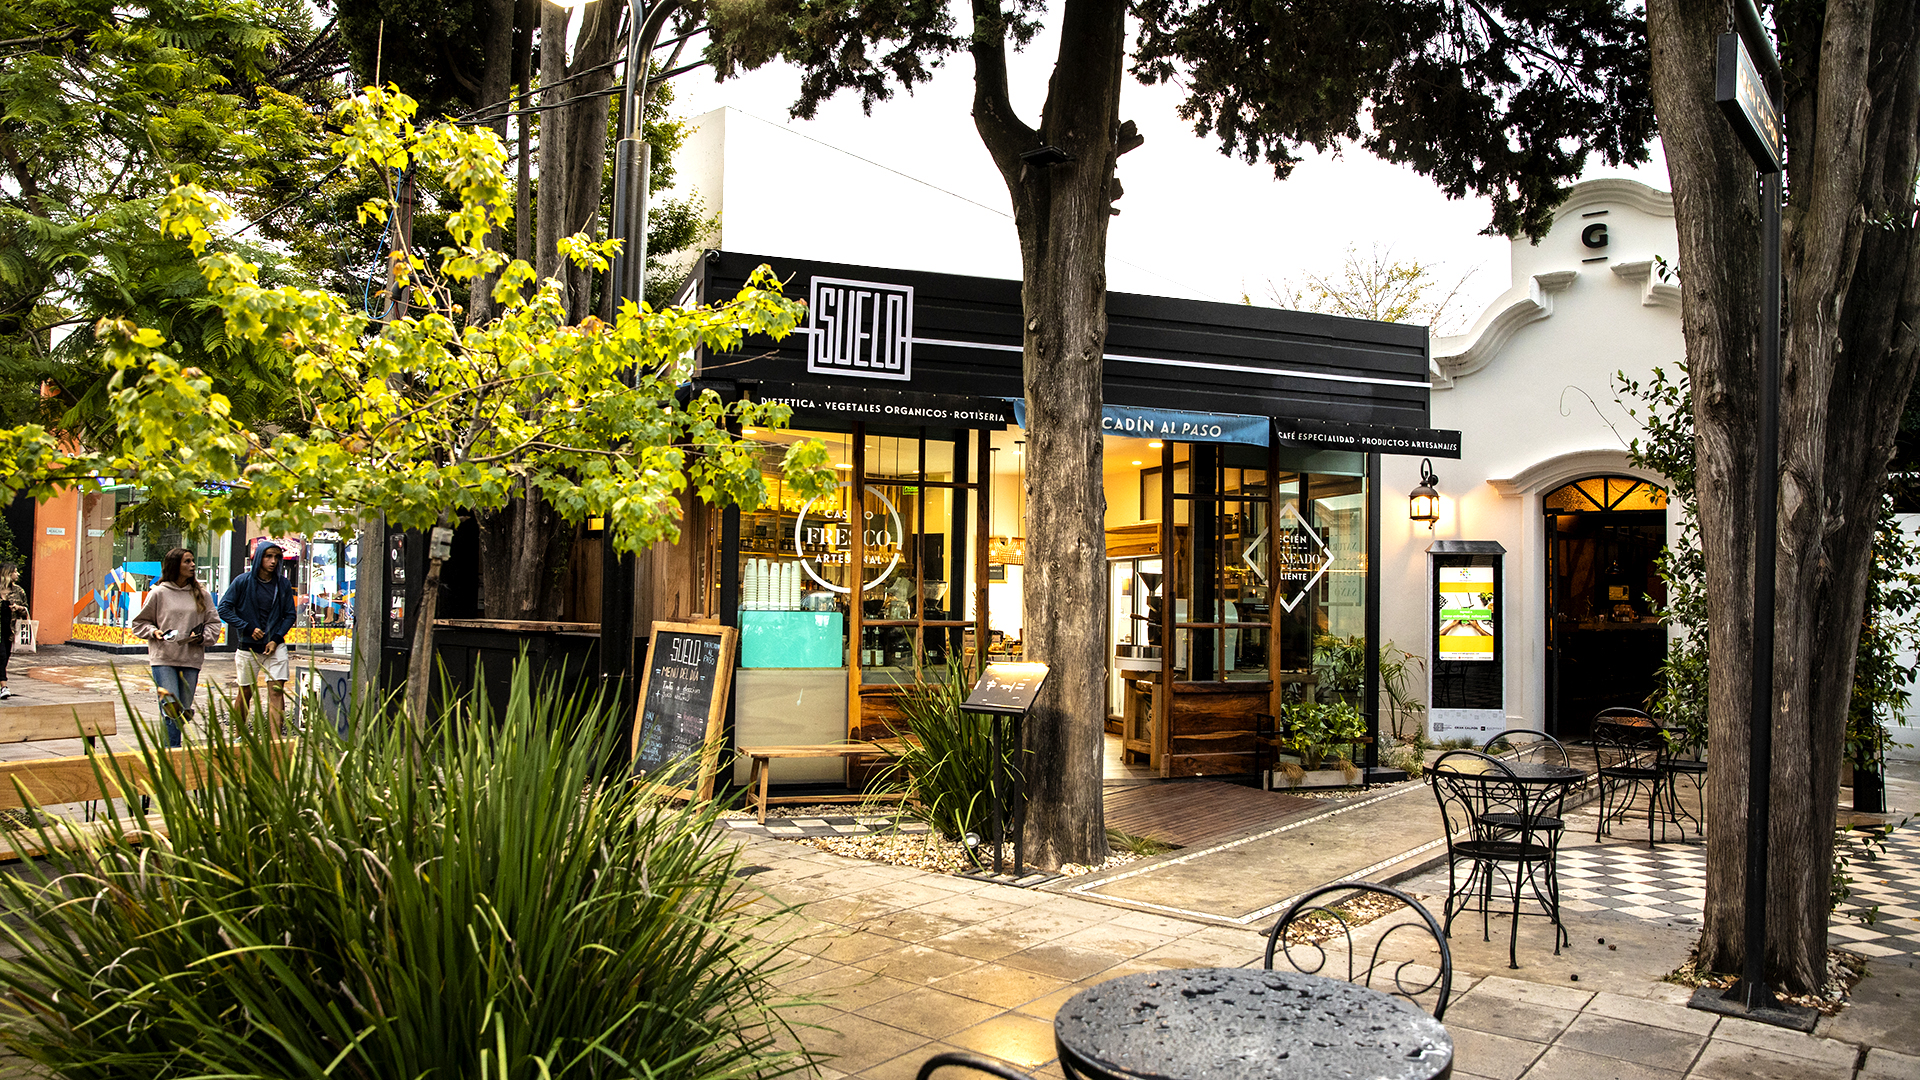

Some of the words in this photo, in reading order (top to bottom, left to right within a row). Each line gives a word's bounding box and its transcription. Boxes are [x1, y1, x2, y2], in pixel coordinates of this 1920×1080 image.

[1581, 222, 1609, 249] G
[816, 286, 904, 370] SUELO
[824, 401, 881, 413] VEGETALES
[884, 405, 947, 418] ORGANICOS
[953, 410, 1005, 422] ROTISERIA
[1102, 416, 1154, 432] CADÍN
[1160, 421, 1176, 434] AL
[1181, 422, 1222, 438] PASO
[1278, 431, 1296, 440] CAFÉ
[1298, 432, 1355, 444] ESPECIALIDAD
[1361, 437, 1410, 447] PRODUCTOS
[1411, 441, 1458, 451] ARTESANALES
[825, 510, 873, 519] CASO
[807, 528, 891, 546] FRECO
[815, 553, 882, 565] ARTESNAL
[1280, 573, 1307, 581] LIENTE
[671, 637, 701, 667] SUELO
